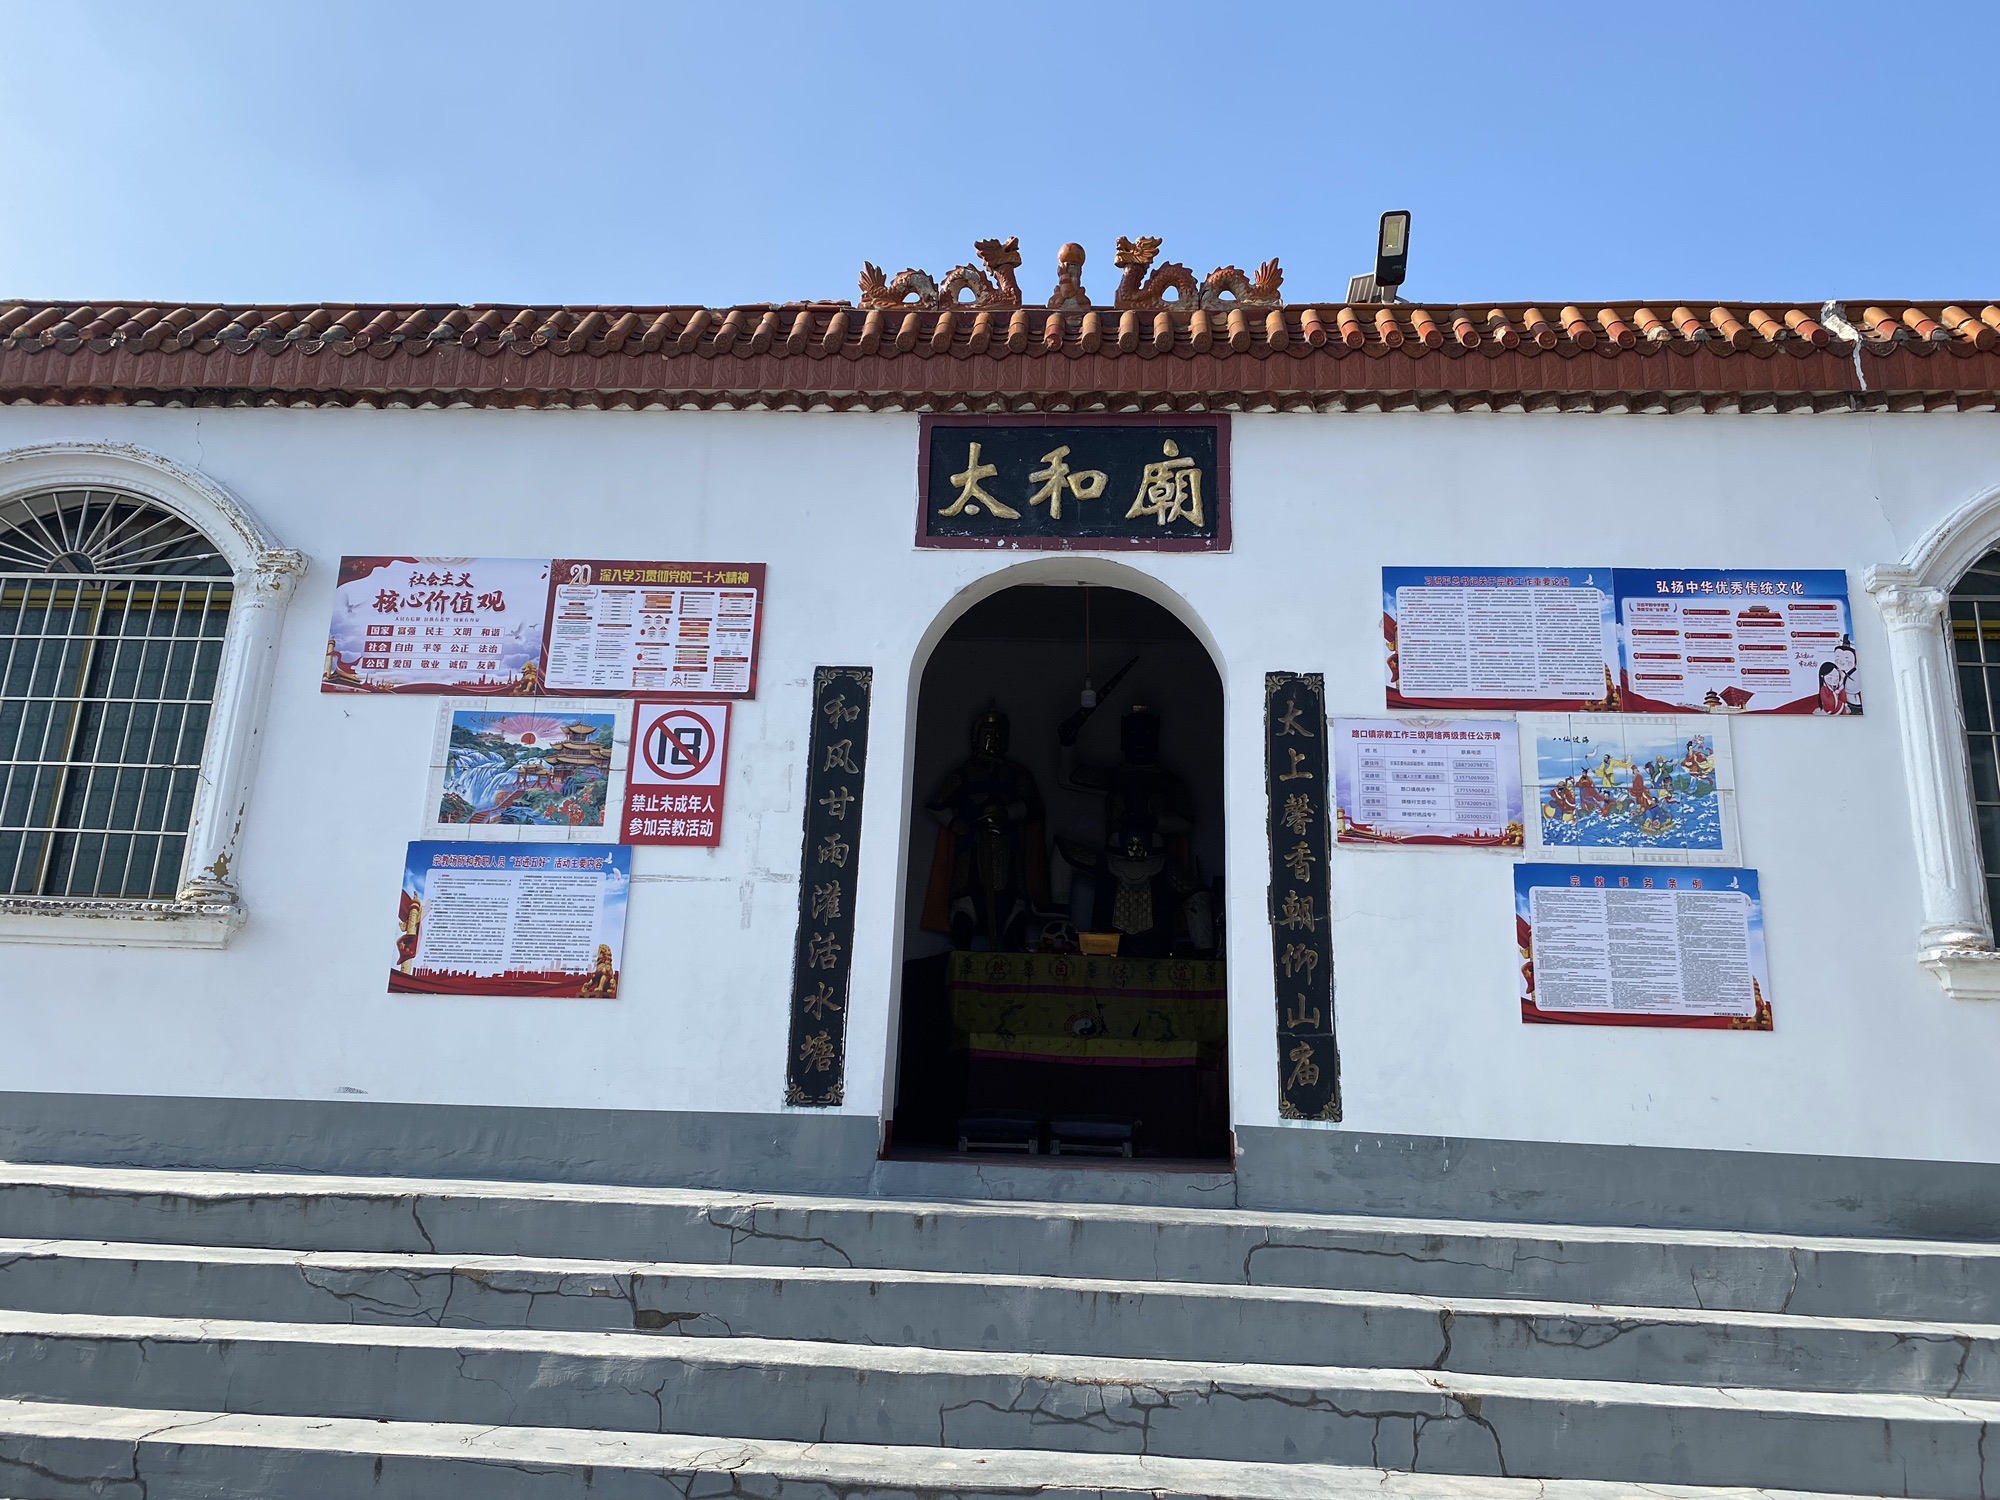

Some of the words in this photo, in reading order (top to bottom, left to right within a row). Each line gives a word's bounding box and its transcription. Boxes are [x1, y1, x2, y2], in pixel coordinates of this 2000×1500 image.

[937, 438, 1205, 527] 太和廟
[409, 571, 474, 588] 社会主义
[599, 568, 749, 585] 深入学习贯彻党的二十大精神
[1424, 576, 1570, 587] 习近平总书记关于宗教工作重要论述
[1655, 580, 1805, 595] 弘扬中华优秀传统文化
[372, 588, 506, 615] 核心价值观
[370, 626, 390, 635] 国家
[397, 627, 416, 635] 富强
[425, 627, 444, 636] 民主
[453, 628, 472, 637] 文明
[481, 628, 500, 637] 和谐
[367, 643, 387, 652] 社会
[394, 643, 414, 652] 自由
[422, 643, 442, 653] 平等
[450, 644, 469, 653] 公正
[478, 644, 498, 653] 法治
[365, 659, 385, 668] 公民
[392, 659, 412, 669] 爱国
[420, 660, 440, 669] 敬业
[448, 660, 468, 669] 诚信
[476, 660, 496, 670] 友善
[1352, 729, 1501, 740] 路口镇宗教工作三级网络两级责任公示牌
[657, 727, 703, 765] 18
[630, 794, 715, 813] 禁止未成年人
[629, 818, 713, 837] 参加宗教活动
[1570, 875, 1702, 890] 宗教事务条例
